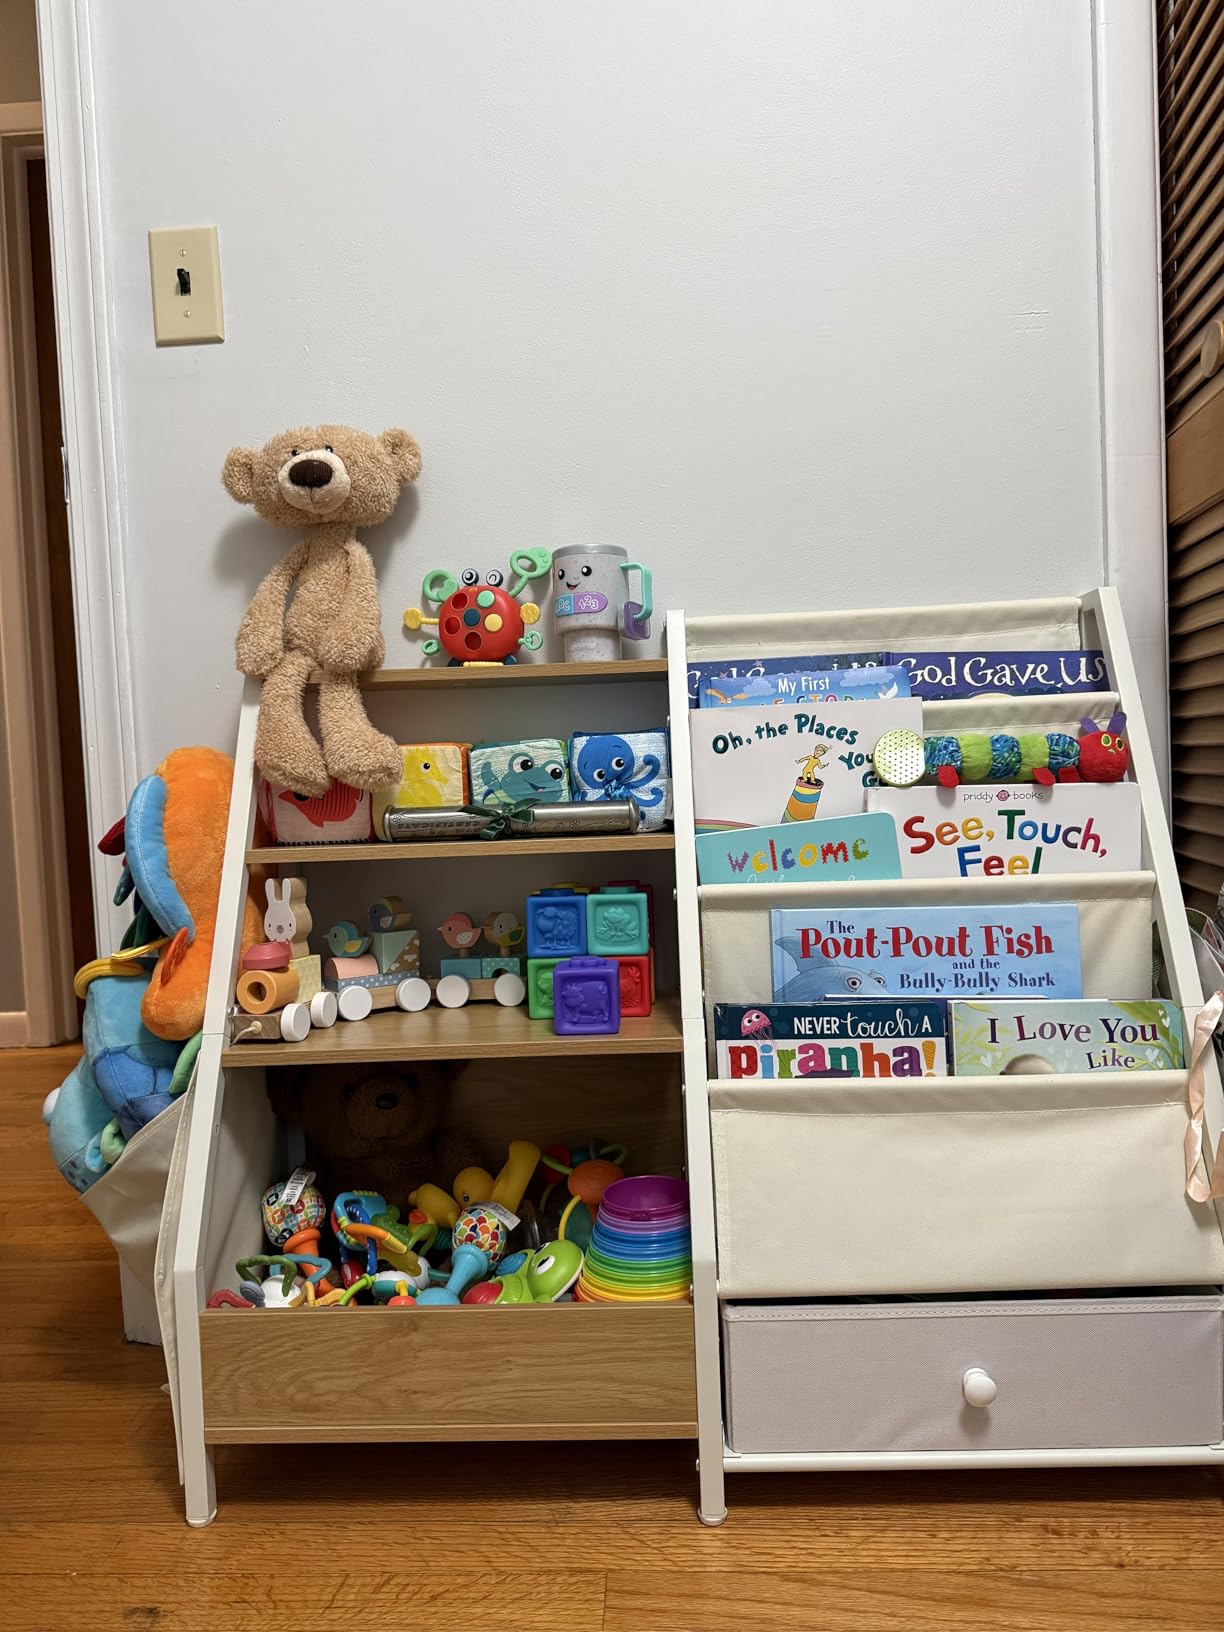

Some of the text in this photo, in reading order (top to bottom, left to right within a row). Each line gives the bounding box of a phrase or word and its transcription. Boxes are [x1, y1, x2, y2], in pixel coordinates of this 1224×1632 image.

[578, 595, 599, 609] 123
[777, 676, 830, 697] My First
[897, 657, 957, 687] God
[963, 657, 1054, 687] Gave
[1055, 657, 1105, 688] Us
[711, 713, 860, 754] Oh, the Places
[963, 790, 1044, 803] priddy books
[903, 810, 1107, 858] See, Touch,
[727, 837, 869, 874] welcome
[956, 844, 1043, 877] Feel
[795, 924, 1055, 959] Pout-Pout Fish
[826, 920, 855, 934] The
[952, 958, 1000, 970] and the
[899, 972, 1056, 992] Bully-Bully Shark
[793, 1008, 932, 1038] NEVER touch A
[986, 1015, 1161, 1044] I Love You
[728, 1039, 937, 1079] piranha!
[1086, 1048, 1136, 1070] Like
